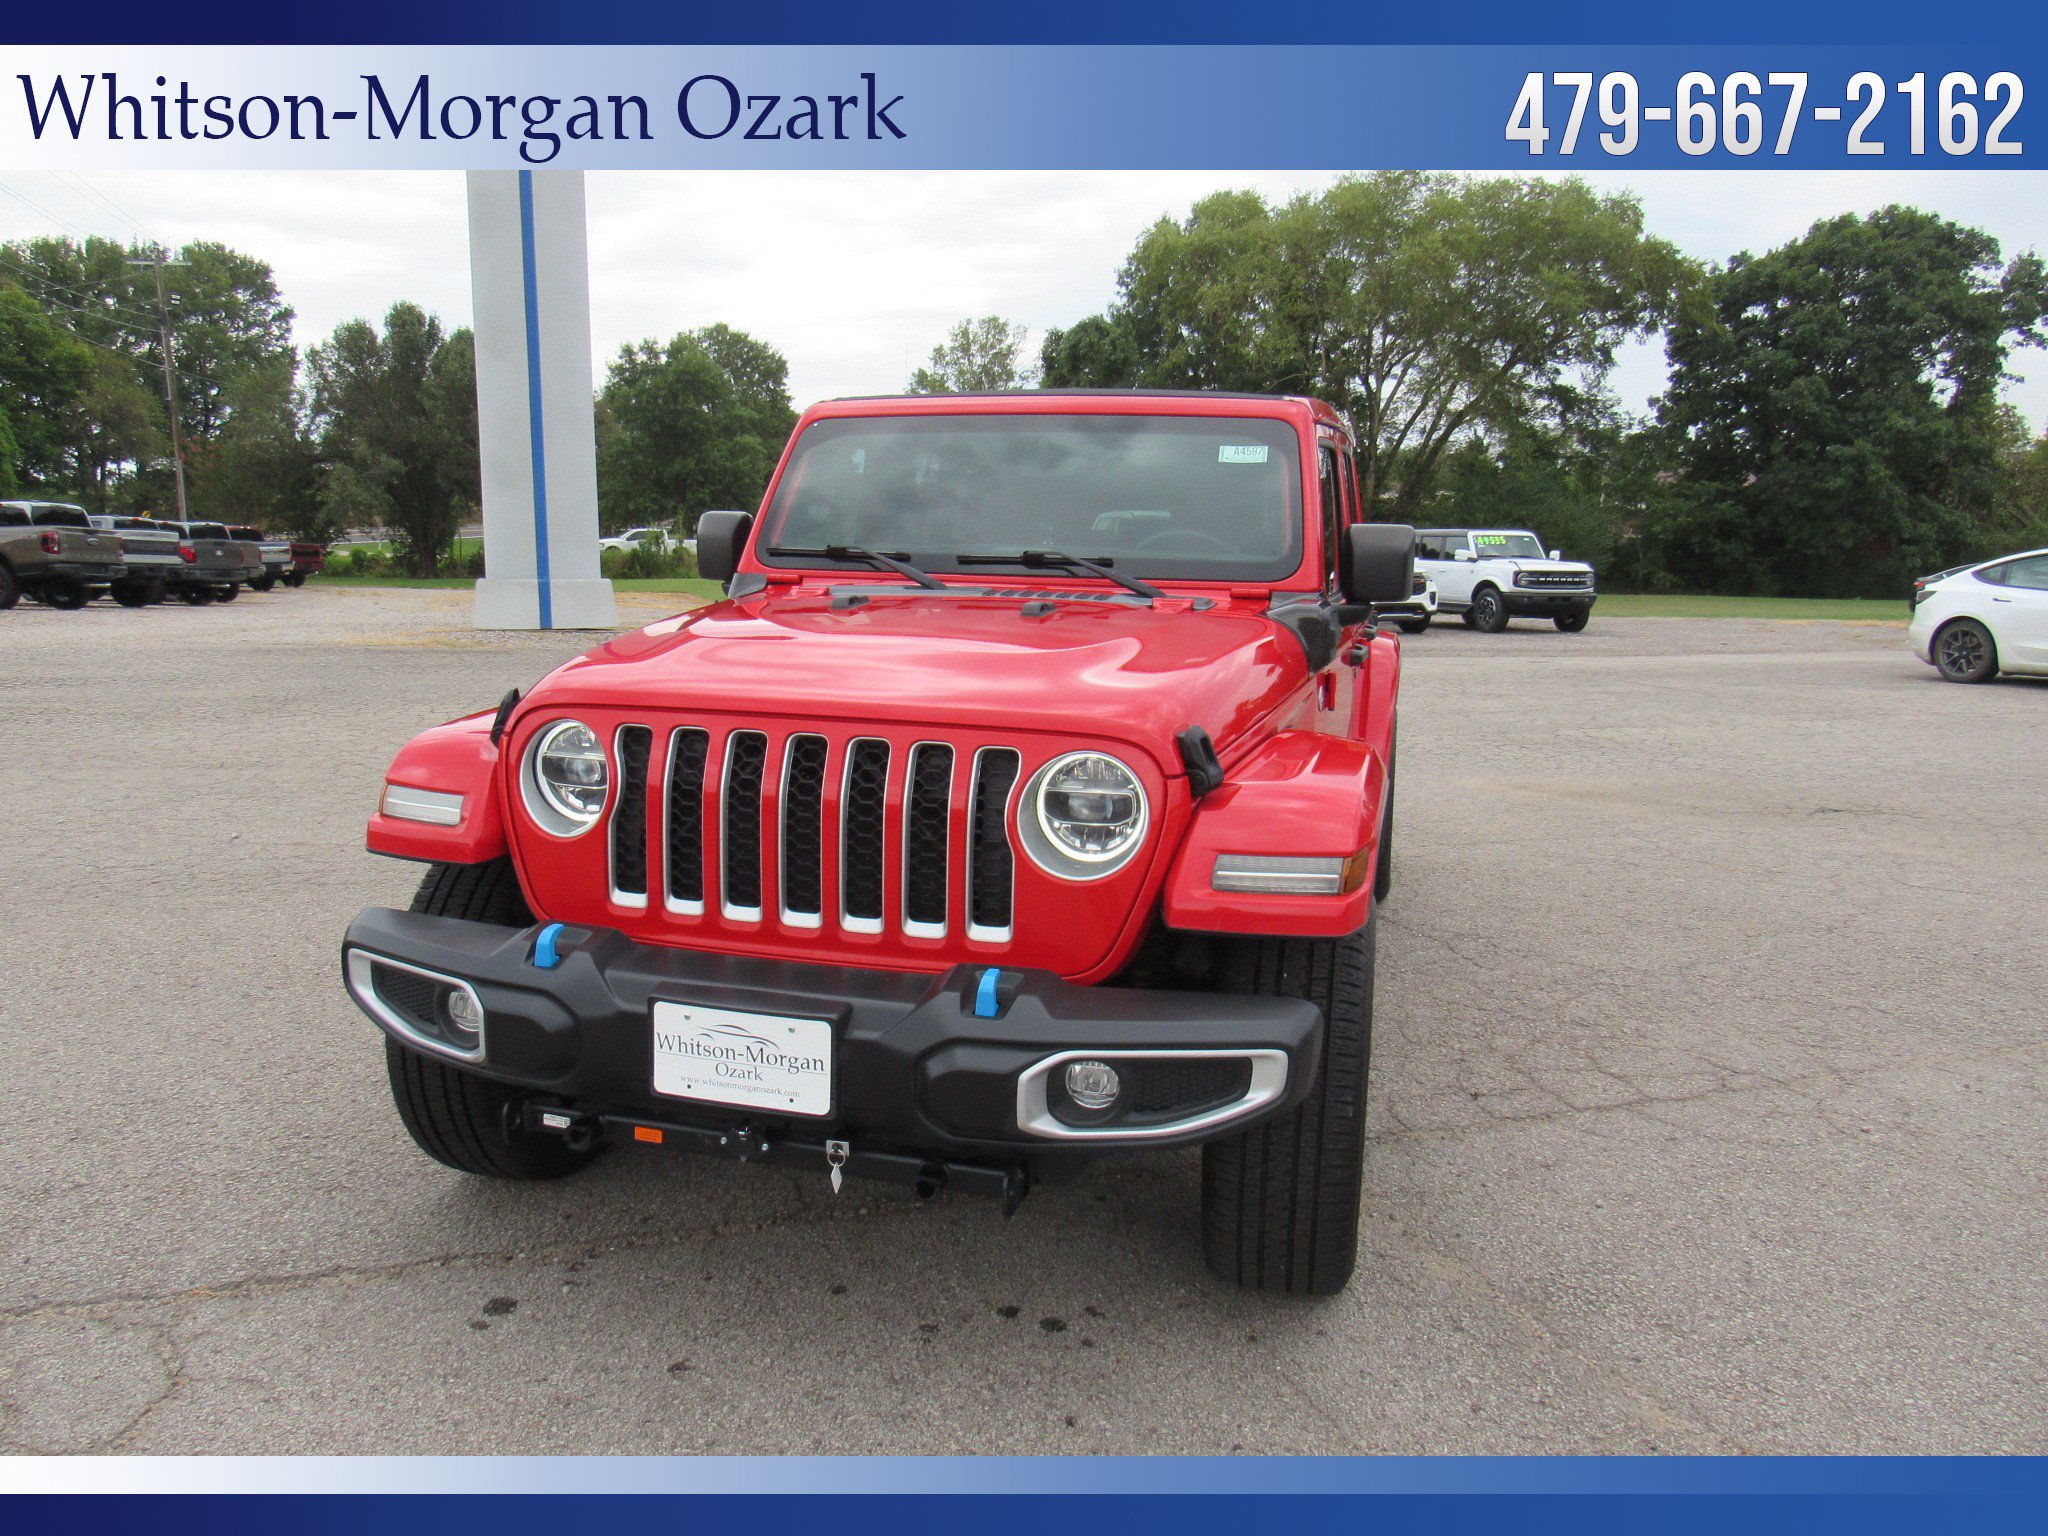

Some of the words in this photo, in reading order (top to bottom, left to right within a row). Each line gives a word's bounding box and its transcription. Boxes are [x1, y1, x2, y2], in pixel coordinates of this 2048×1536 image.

[1233, 446, 1263, 456] A4597
[656, 1032, 826, 1075] Whitson-Morgan
[715, 1062, 763, 1081] Ozark
[680, 1075, 800, 1098] www.whitsonmorganozark.com
